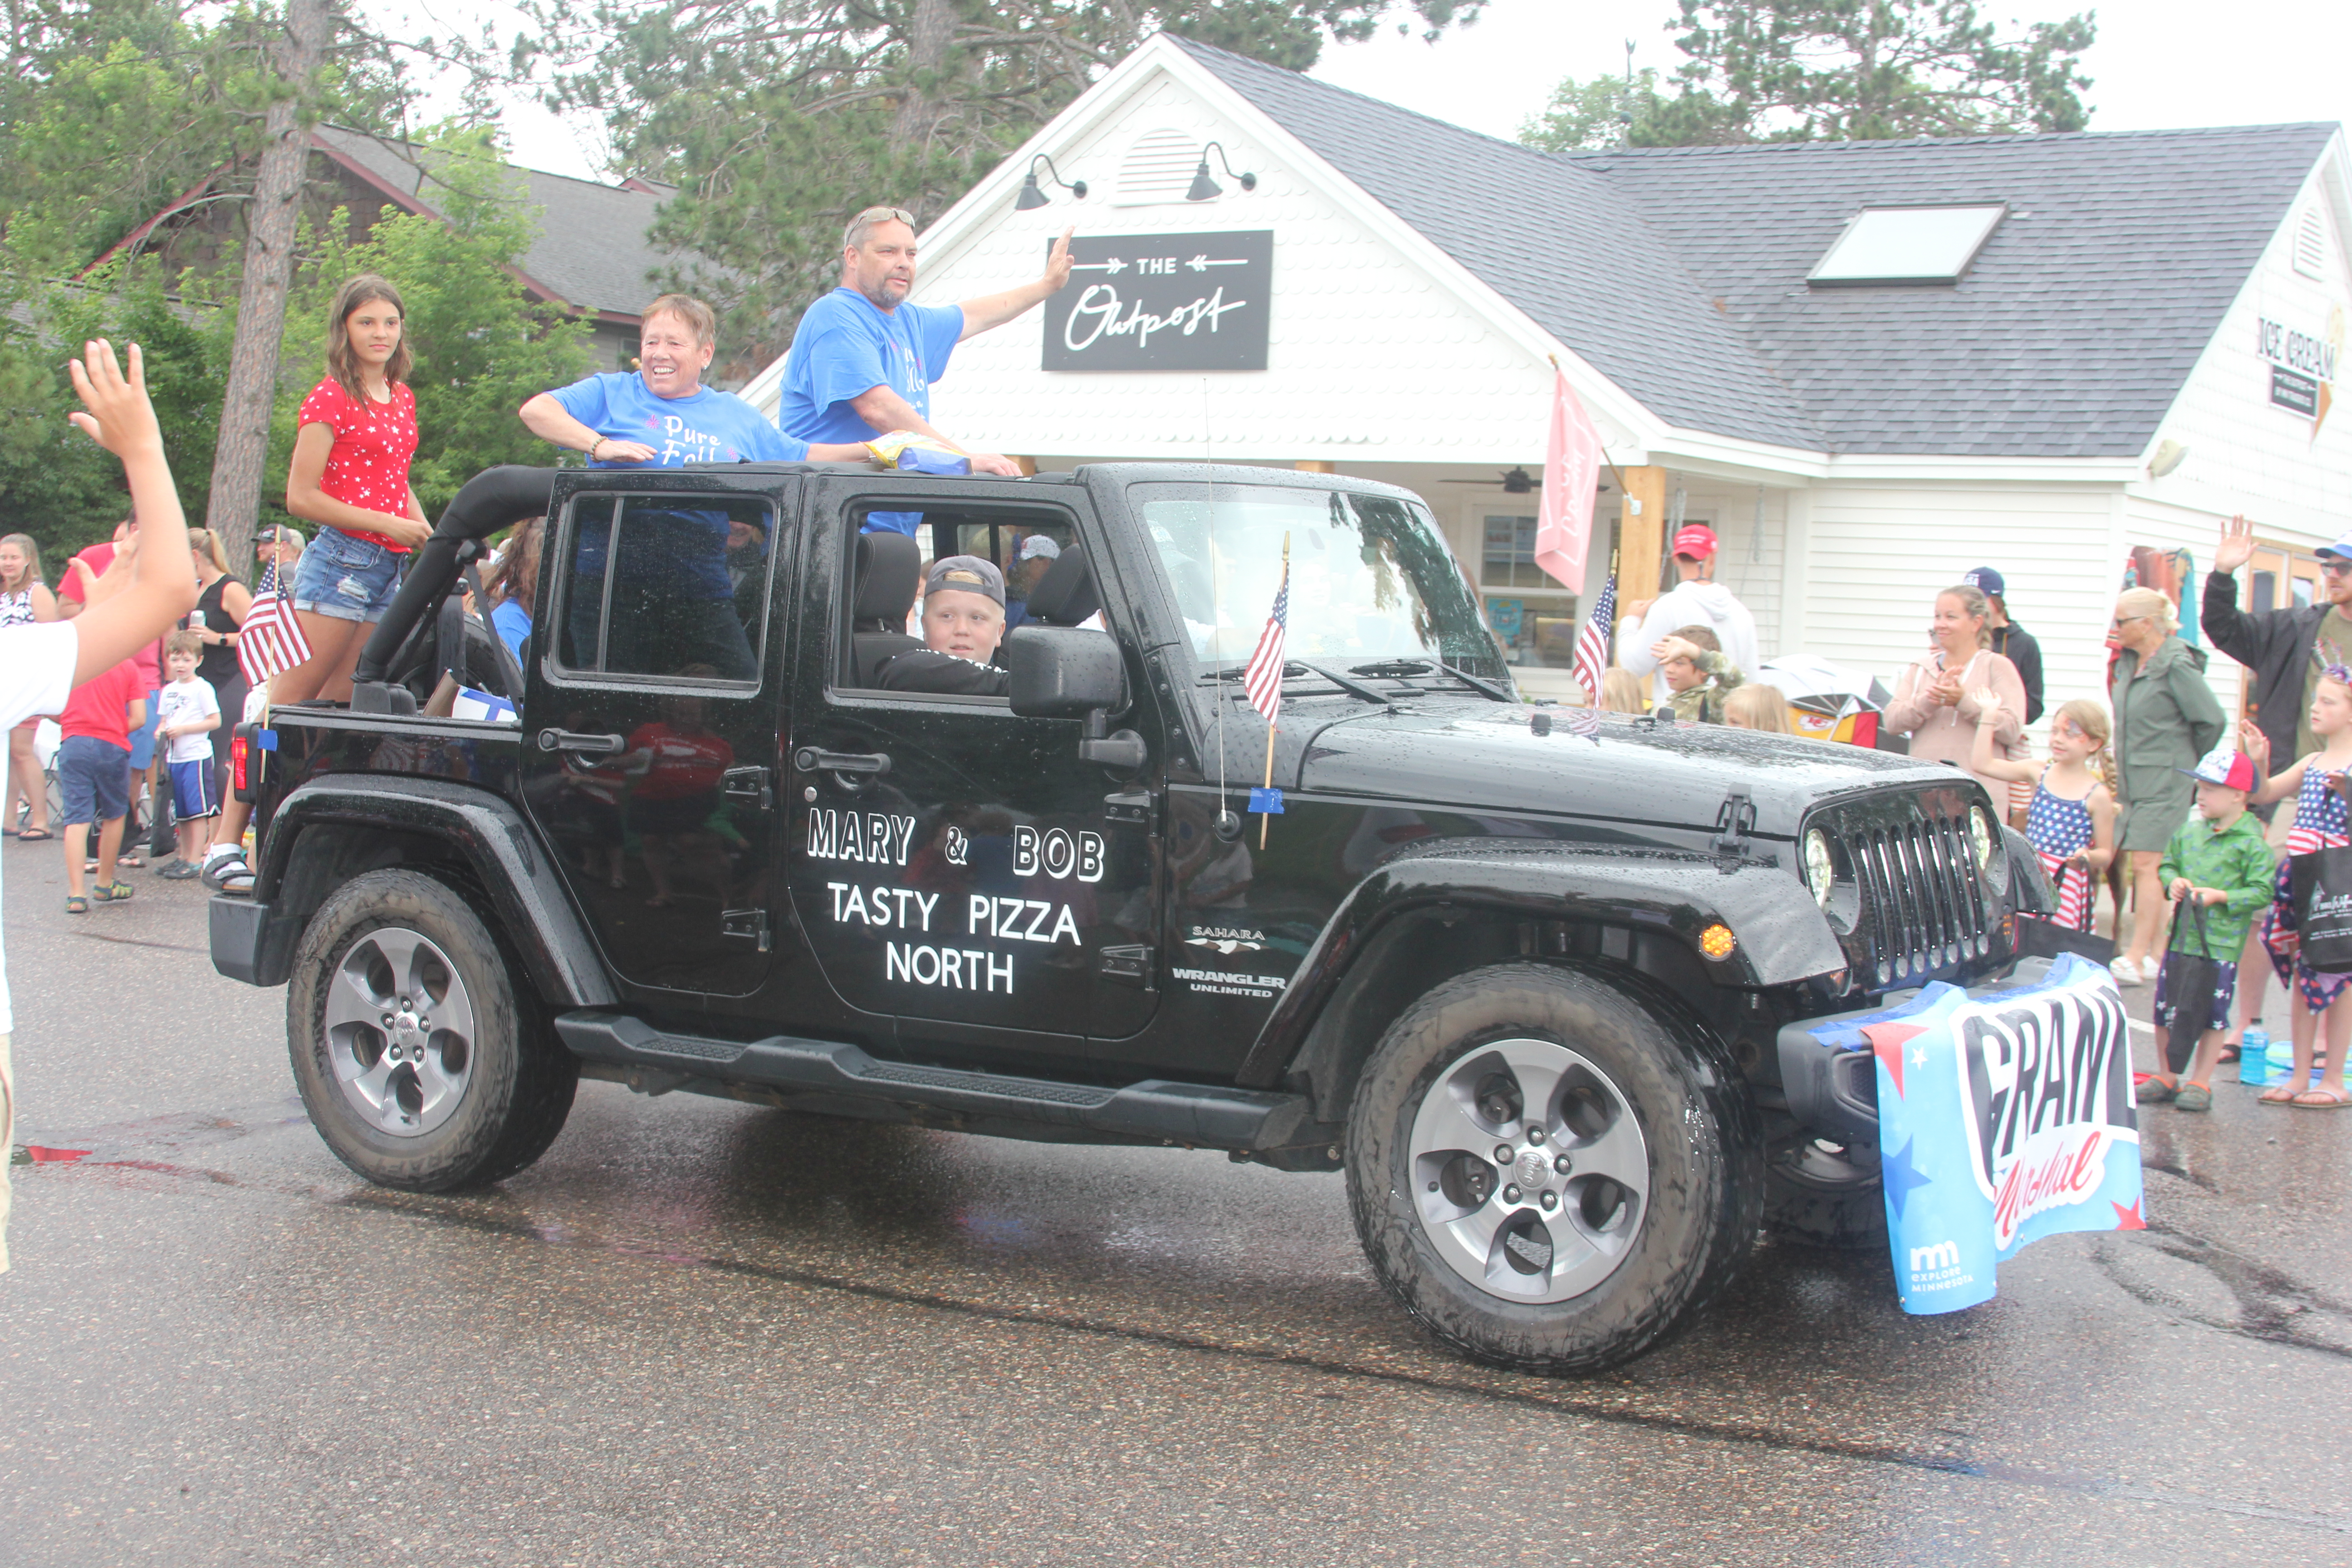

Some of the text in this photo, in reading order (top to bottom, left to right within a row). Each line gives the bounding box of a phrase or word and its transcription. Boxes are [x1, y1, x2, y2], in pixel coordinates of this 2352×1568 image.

[1137, 258, 1176, 274] THE
[1064, 284, 1246, 351] Outpost
[2259, 317, 2335, 380] ICE CREAM
[664, 416, 721, 446] Pure
[808, 808, 1105, 882] MARY & BOB
[828, 882, 1081, 946] TASTY PIZZA
[1192, 926, 1265, 940] SAHARA
[887, 941, 1013, 994] NORTH
[1172, 967, 1287, 990] WRANGLER
[1190, 983, 1273, 997] UNLIMITED
